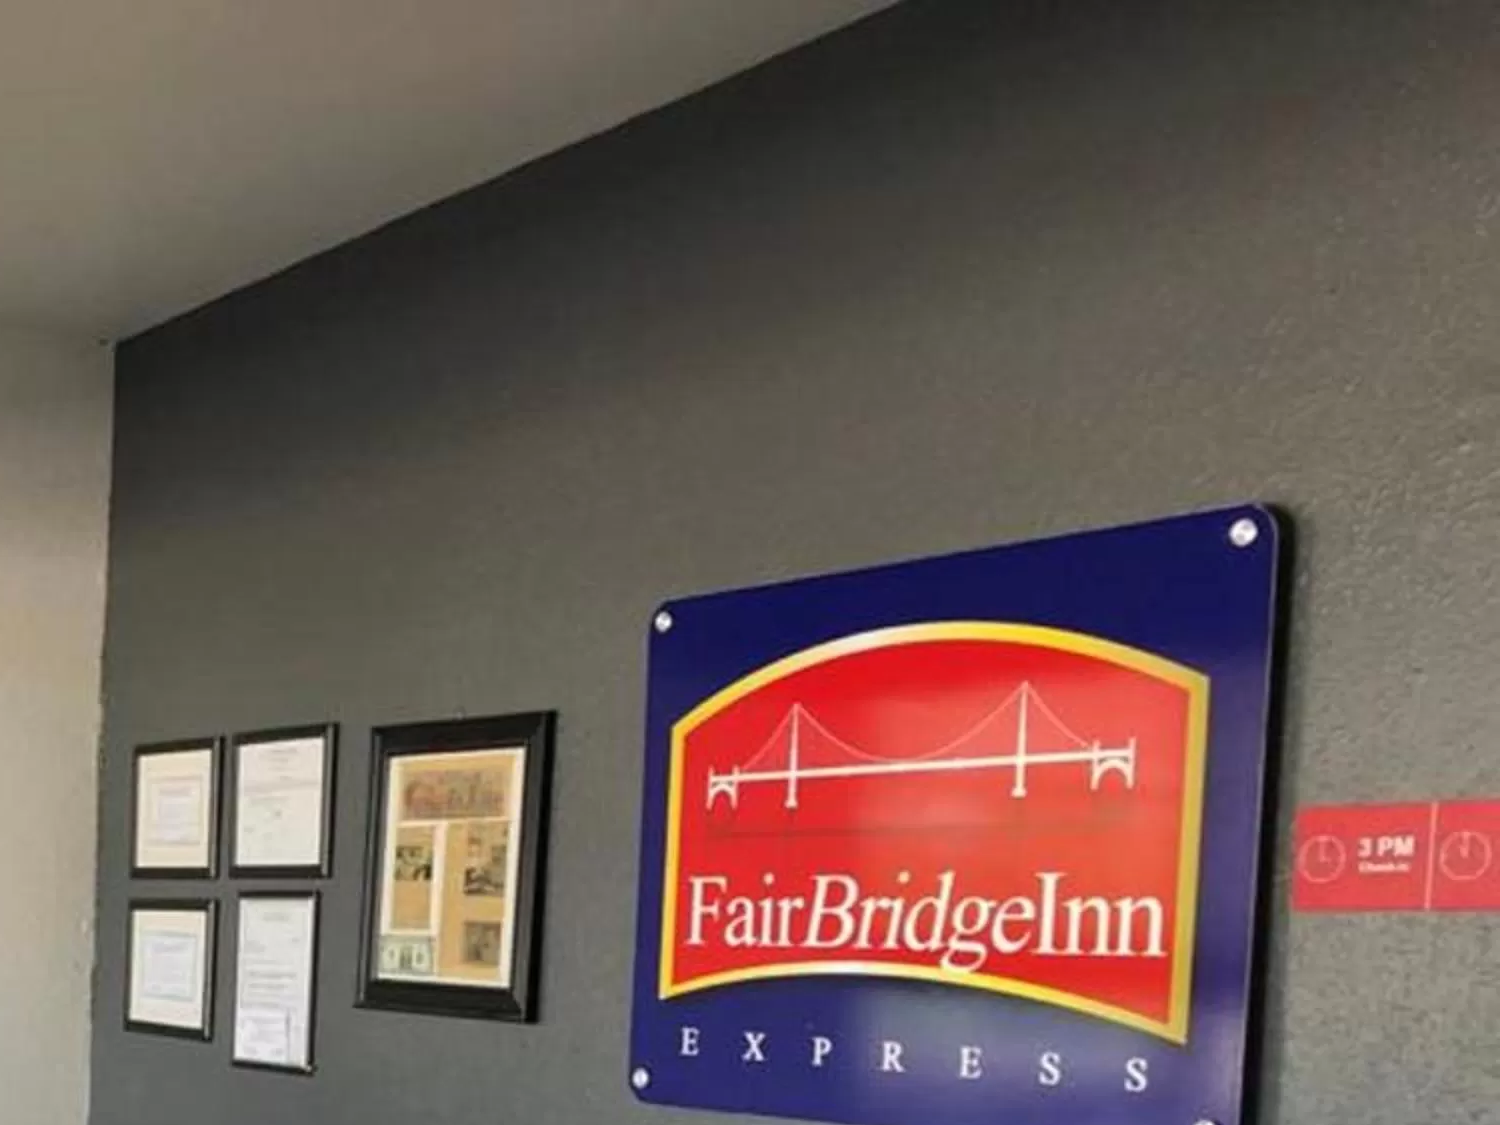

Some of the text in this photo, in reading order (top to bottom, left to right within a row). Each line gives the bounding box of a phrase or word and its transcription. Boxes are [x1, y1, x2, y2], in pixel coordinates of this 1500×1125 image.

[1357, 833, 1416, 858] 3 PM
[680, 1026, 1149, 1094] EXPRESS
